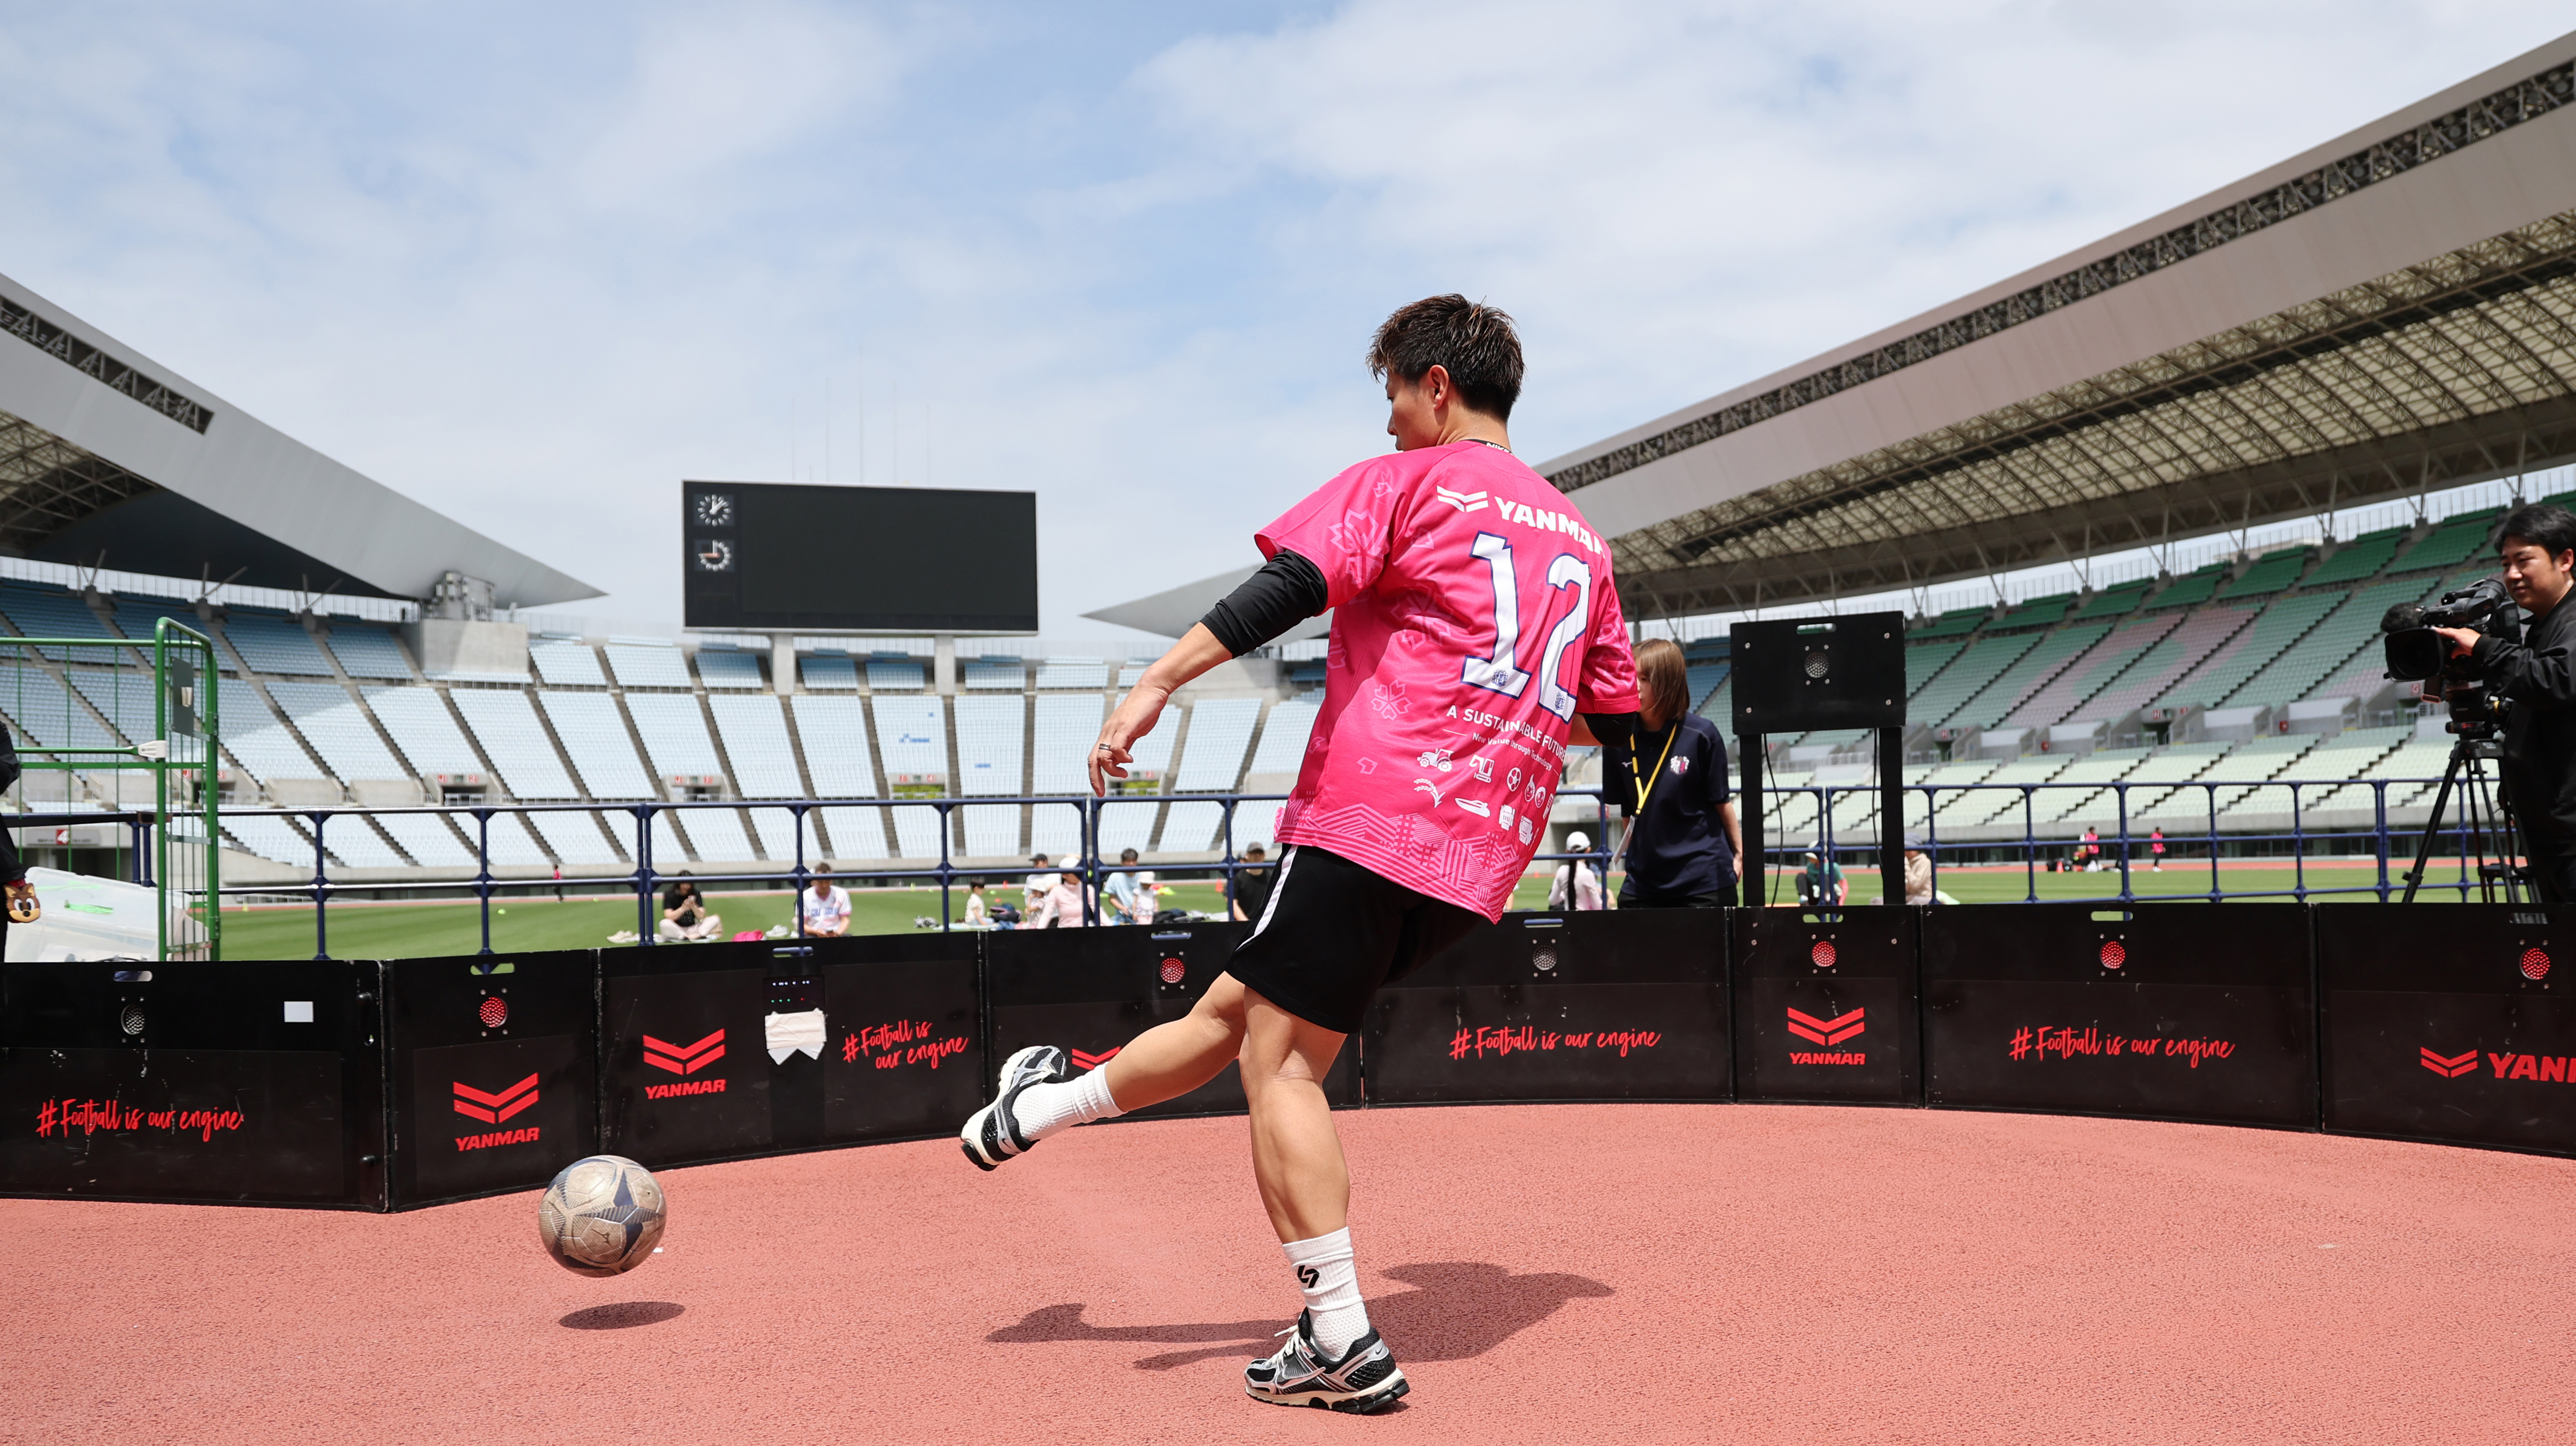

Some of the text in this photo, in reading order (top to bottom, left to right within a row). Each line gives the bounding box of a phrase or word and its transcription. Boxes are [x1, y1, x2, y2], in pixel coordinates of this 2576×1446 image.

[1461, 530, 1592, 725] 12
[1446, 705, 1566, 762] A SUSTAINABLE FUTURE
[1472, 732, 1487, 744] New
[1488, 737, 1510, 745] Value
[1510, 739, 1531, 756] through
[1531, 749, 1552, 772] Technology
[57, 829, 70, 845] 4
[842, 1019, 933, 1063] #Football is
[875, 1037, 969, 1069] our engine
[1449, 1026, 1662, 1060] #Football is our engine
[1789, 1052, 1866, 1065] YANMAR
[2009, 1026, 2236, 1069] #Football is our engine
[644, 1078, 727, 1100] YANMAR
[36, 1098, 244, 1142] #Football is our engine
[455, 1127, 541, 1151] YANMAR
